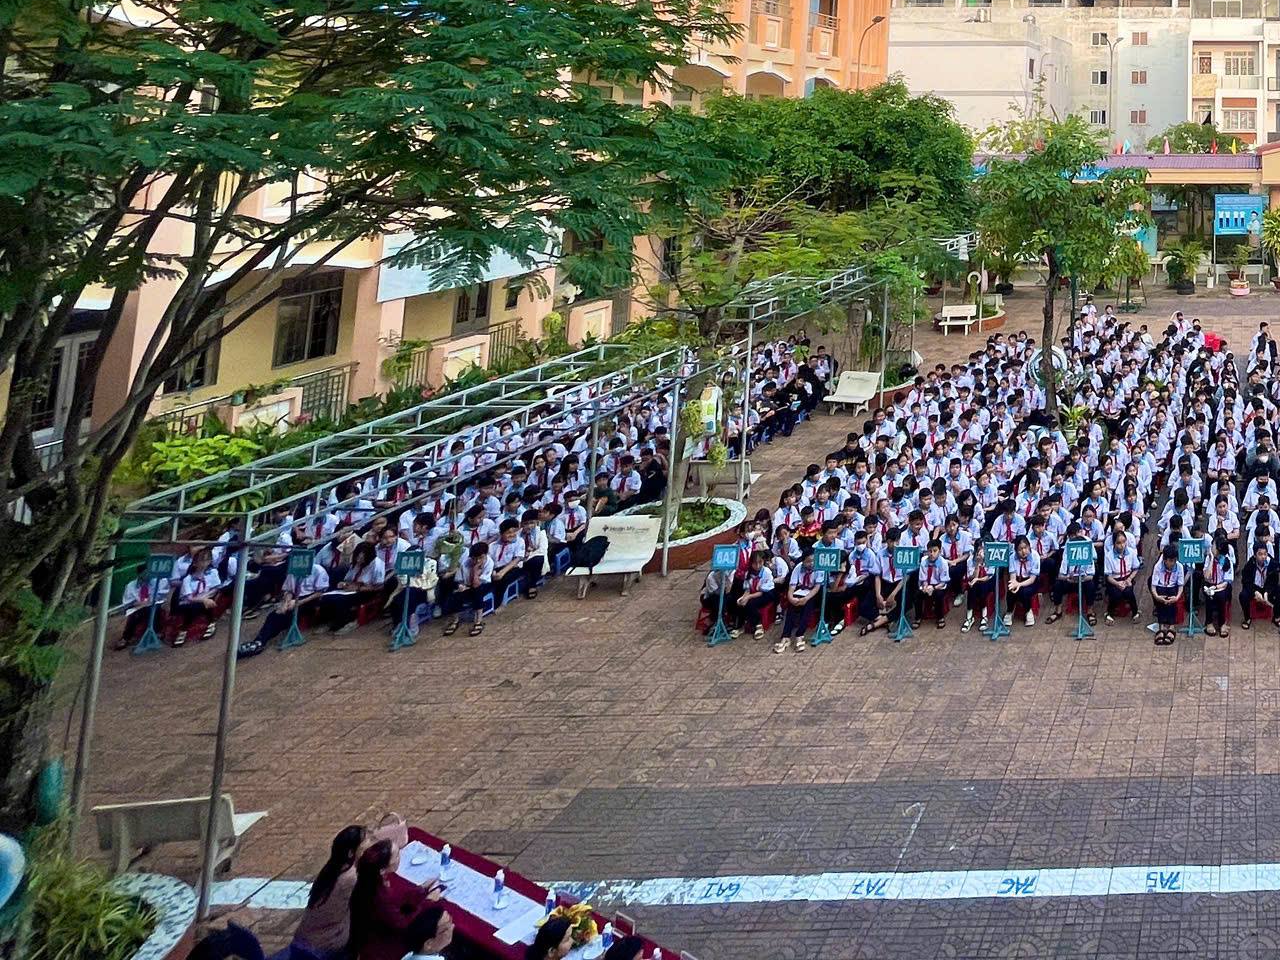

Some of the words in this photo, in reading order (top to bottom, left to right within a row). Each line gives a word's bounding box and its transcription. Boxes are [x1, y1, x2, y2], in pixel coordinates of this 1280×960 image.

[716, 550, 735, 565] 6A3
[896, 550, 914, 565] 6A1
[988, 548, 1007, 561] 7A7
[1070, 546, 1089, 560] 7A6
[1183, 543, 1200, 558] 7A5
[400, 556, 421, 570] 6A4
[818, 552, 837, 567] 6A2
[851, 878, 887, 897] 7A7
[998, 874, 1036, 895] 7A6
[1146, 871, 1181, 891] 7A5
[704, 882, 742, 899] 6A1
